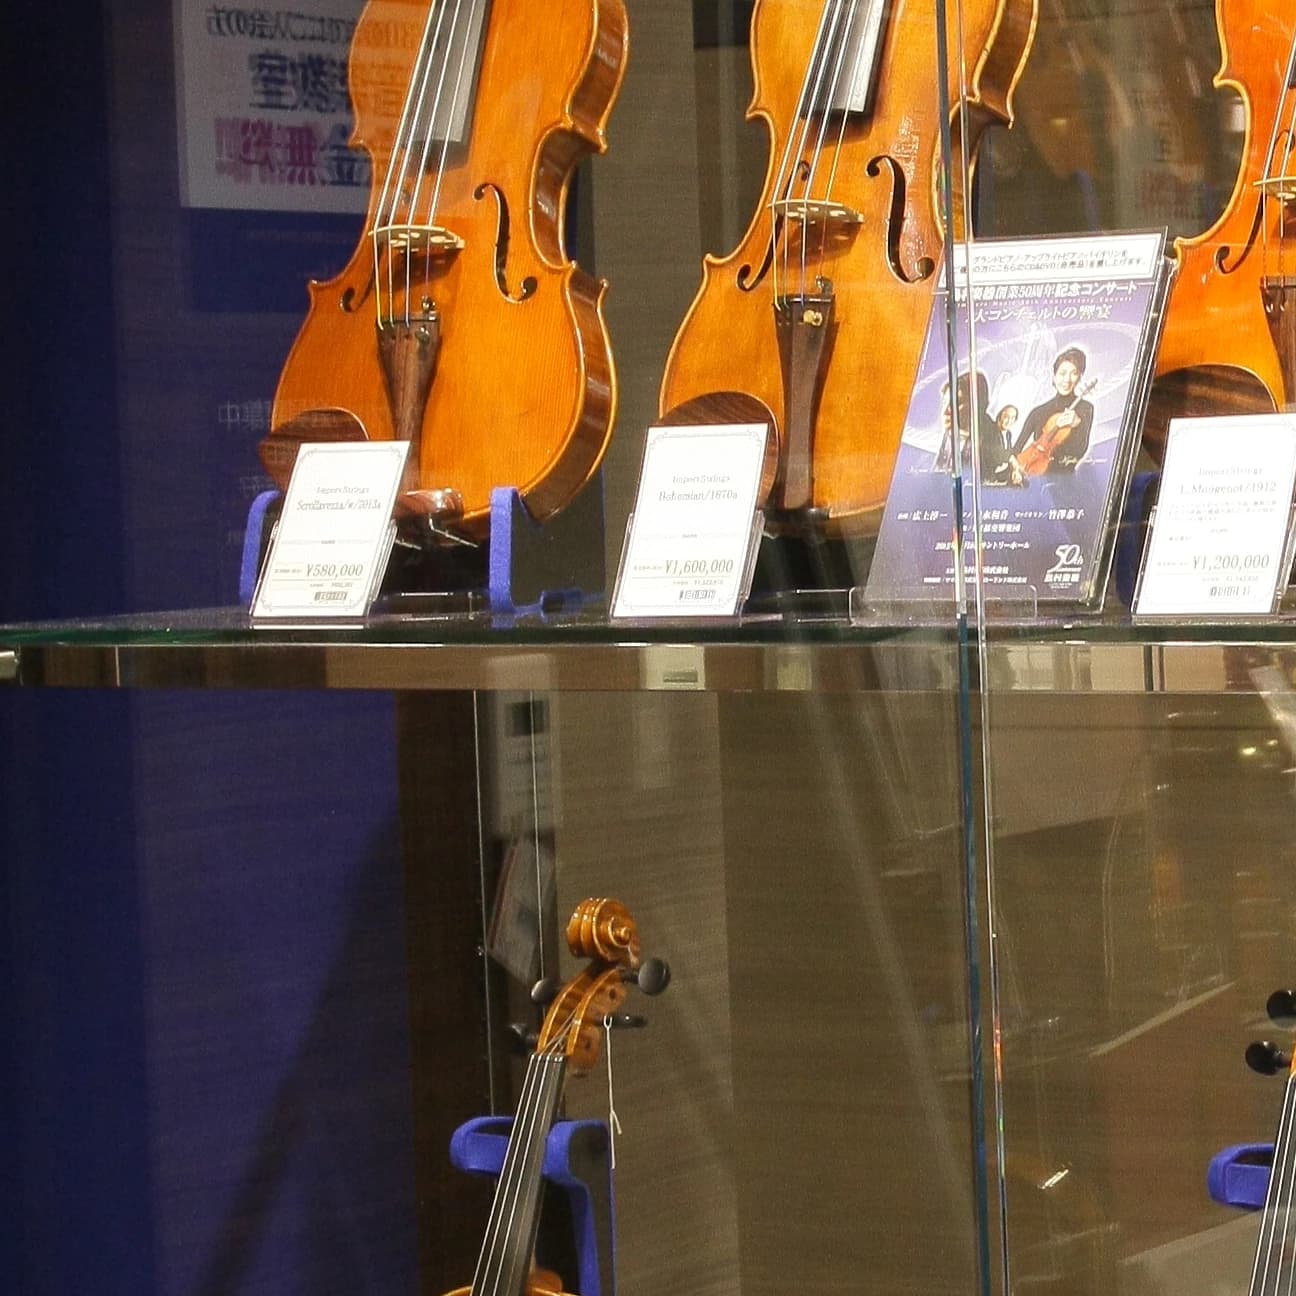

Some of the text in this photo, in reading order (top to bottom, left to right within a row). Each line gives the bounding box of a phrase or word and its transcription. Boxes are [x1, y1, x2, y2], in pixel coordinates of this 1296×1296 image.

[306, 563, 364, 578] ¥580,000
[665, 559, 735, 576] ¥1,600,000
[1192, 554, 1270, 572] ¥1,200,000
